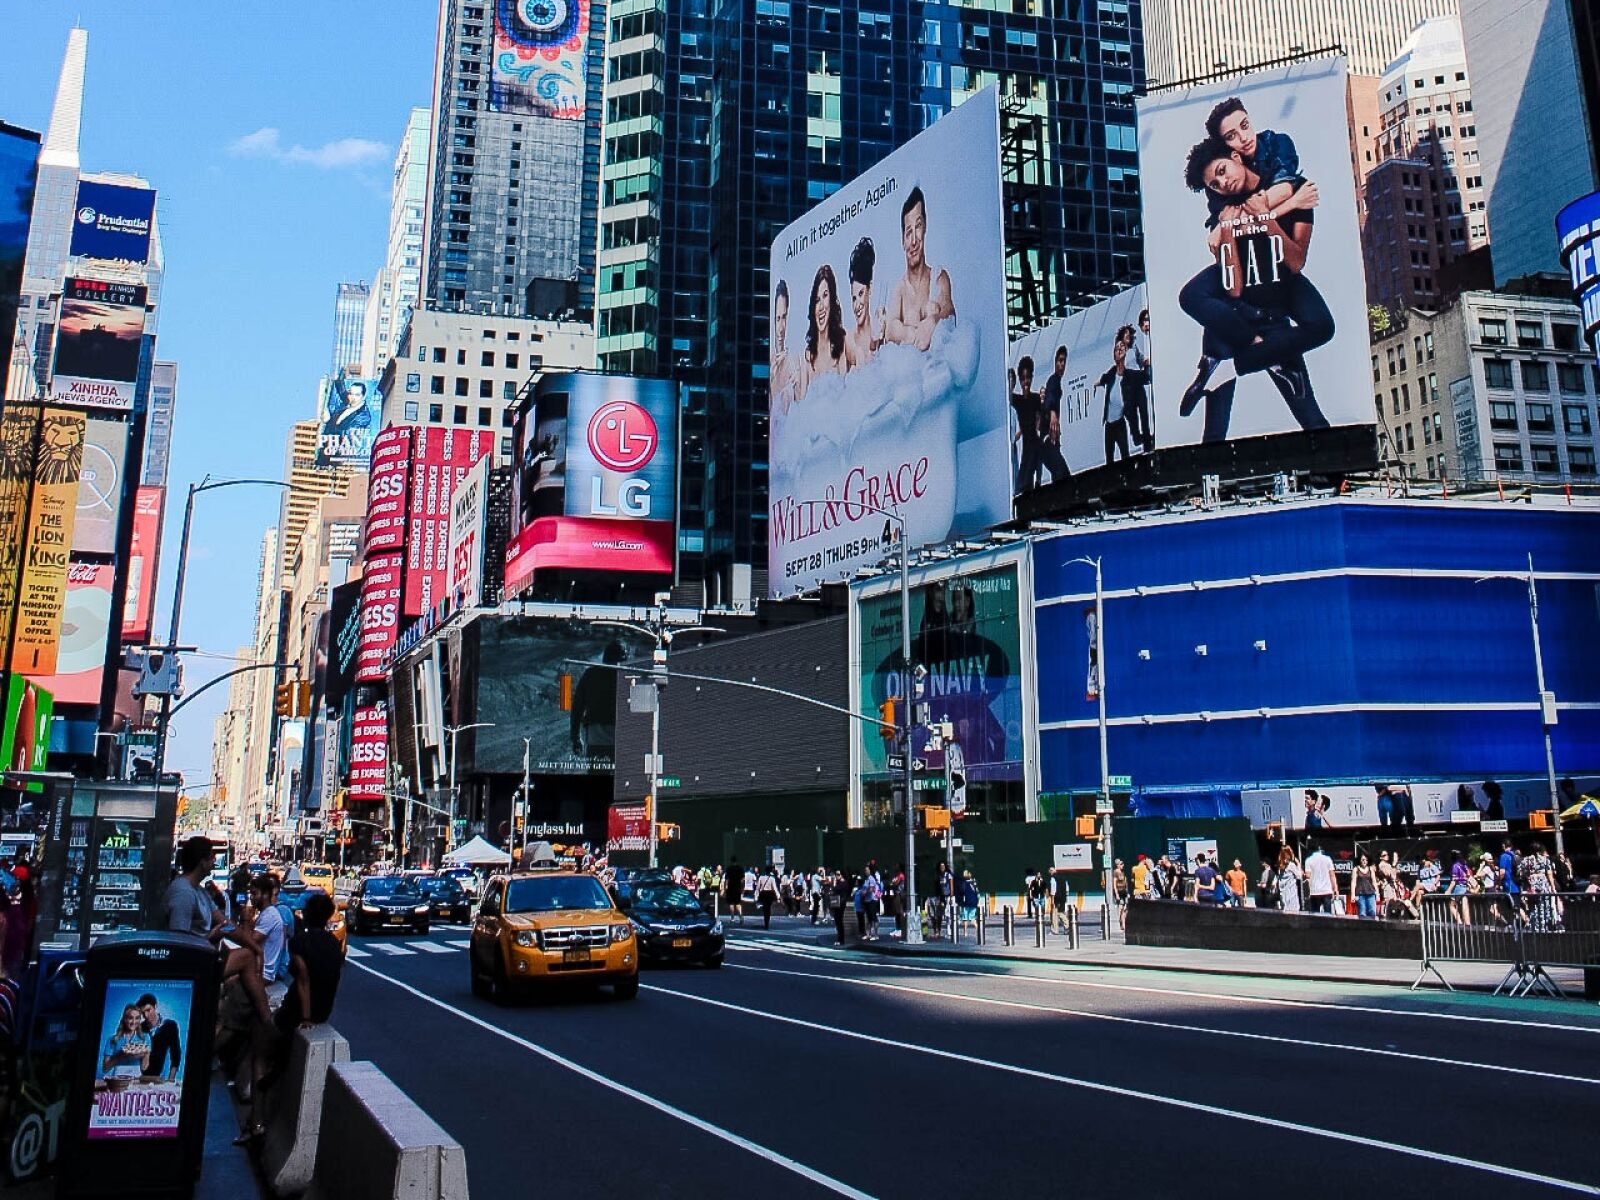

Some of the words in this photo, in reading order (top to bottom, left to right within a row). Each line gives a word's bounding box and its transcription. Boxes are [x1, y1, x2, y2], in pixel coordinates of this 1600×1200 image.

[98, 213, 149, 229] Prudential
[786, 238, 798, 261] All
[800, 235, 808, 252] in
[810, 227, 817, 245] it
[819, 200, 862, 239] together.
[865, 177, 898, 209] Again.
[1221, 214, 1254, 227] meet
[1258, 211, 1277, 221] me
[1232, 228, 1243, 238] in
[1247, 224, 1268, 234] the
[1220, 234, 1285, 290] GAP
[76, 290, 135, 303] GALLERY
[70, 382, 118, 397] XINHUA
[59, 392, 86, 402] NEWS
[88, 394, 128, 406] AGENCY
[590, 475, 651, 517] LG
[40, 513, 62, 526] THE
[34, 525, 65, 544] LION
[592, 540, 645, 550] www.LG.com
[28, 545, 66, 567] KING
[785, 557, 809, 578] SEPT
[809, 553, 822, 570] 28
[826, 541, 860, 565] THURS
[28, 585, 59, 593] TICKETS
[931, 654, 990, 697] NAVY
[566, 821, 584, 835] hut
[104, 836, 129, 848] ATM
[98, 1092, 177, 1117] WAITRESS
